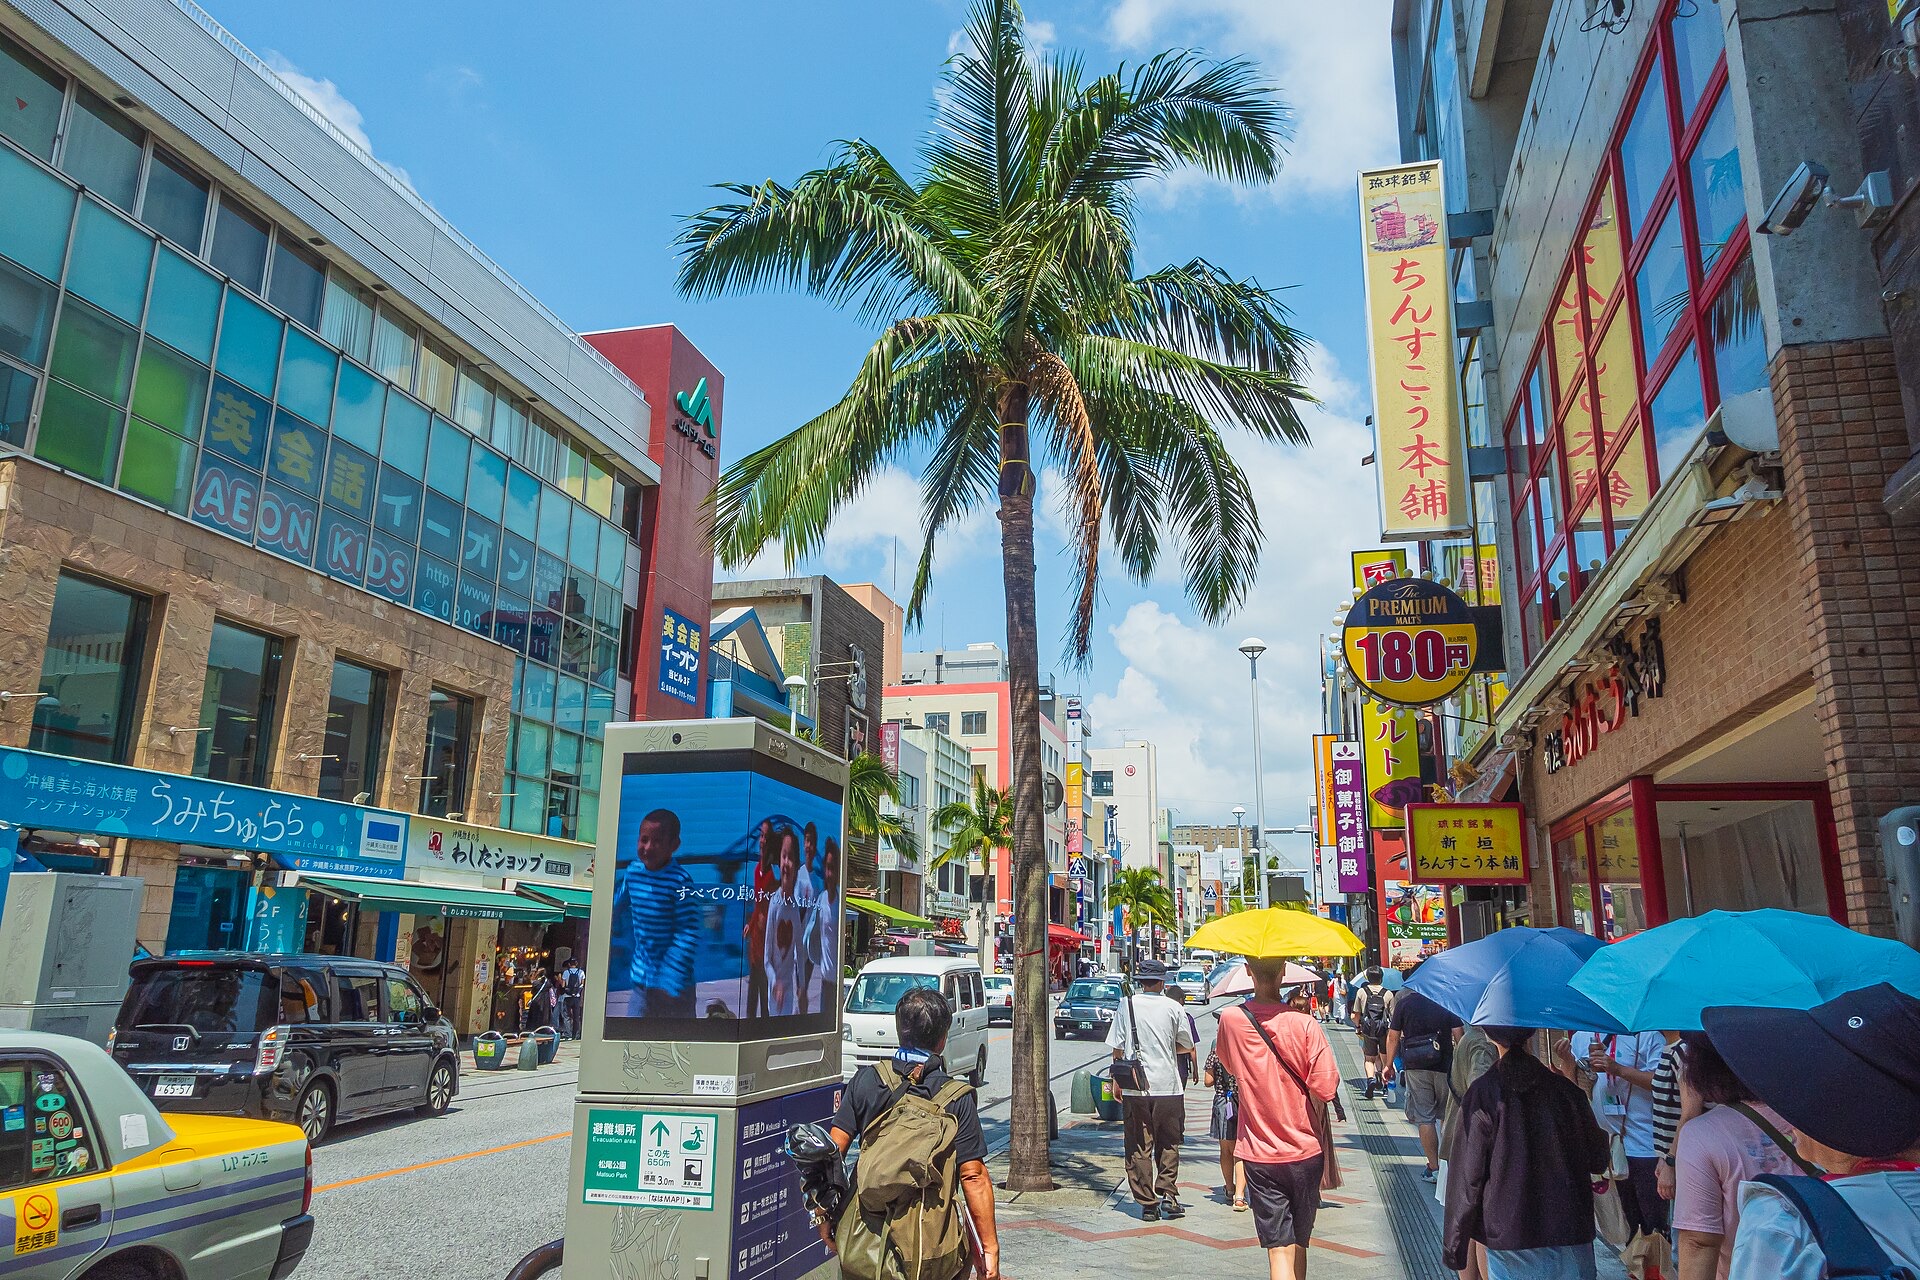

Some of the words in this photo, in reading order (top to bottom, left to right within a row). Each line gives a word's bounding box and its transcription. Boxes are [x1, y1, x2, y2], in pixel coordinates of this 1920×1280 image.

[1369, 169, 1432, 190] 琉球銘菓
[1388, 257, 1451, 522] ちんすこう本舗
[211, 391, 366, 510] 英会話
[382, 494, 528, 581] イーオン
[196, 470, 315, 556] AEON
[328, 524, 410, 596] KIDS
[1388, 584, 1421, 599] The
[1369, 596, 1448, 616] PREMIUM
[662, 614, 700, 653] 英会話
[662, 643, 699, 672] イーオン
[24, 772, 138, 804] 沖縄美ら海水族館
[24, 796, 131, 820] アンテナショップ
[151, 778, 304, 843] うみちゅらら
[1335, 768, 1359, 877] 御菓子御殿
[1437, 819, 1494, 829] 琉球銘菓
[301, 859, 310, 868] 2F
[452, 841, 544, 873] わしたショップ
[1419, 854, 1519, 871] ちんすこう本舗
[256, 900, 280, 918] 2F
[164, 1084, 192, 1094] 65-57
[53, 1117, 69, 1127] 600
[592, 1122, 637, 1136] 避難場所
[592, 1136, 623, 1144] Evacuation
[647, 1149, 670, 1159] この先
[647, 1158, 671, 1167] 650m
[222, 1156, 238, 1172] LP
[599, 1160, 627, 1170] 松尾公園
[657, 1175, 675, 1186] 3.0m
[17, 1229, 57, 1252] 禁煙車
